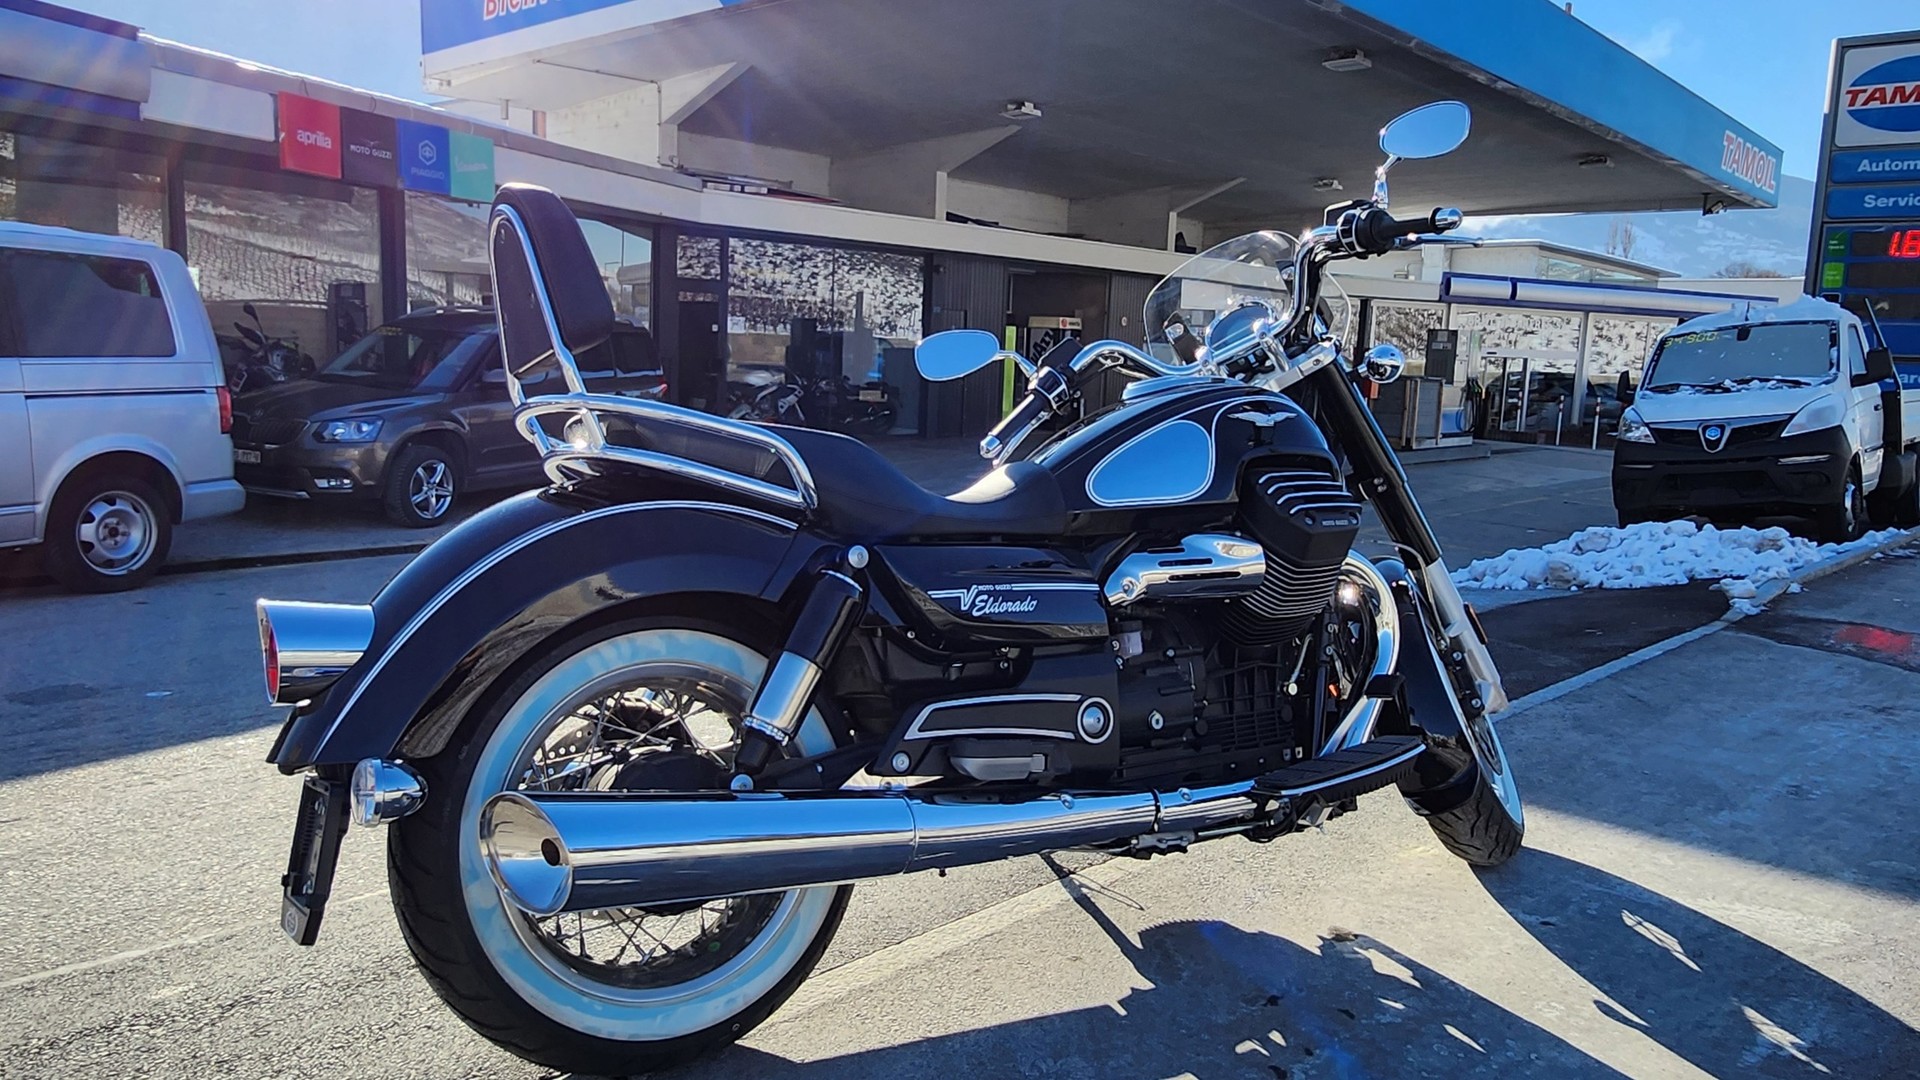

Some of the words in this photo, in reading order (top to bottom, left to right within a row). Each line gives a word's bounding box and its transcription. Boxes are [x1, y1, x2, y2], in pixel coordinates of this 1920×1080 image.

[1845, 84, 1920, 107] TAM
[297, 129, 332, 149] aprilia
[350, 144, 371, 155] MOTO
[372, 148, 393, 160] GUZZI
[1721, 130, 1775, 194] TAMOIL
[411, 167, 445, 180] PIAGGIO
[1857, 159, 1920, 172] Autom
[972, 595, 1038, 617] Eldorado
